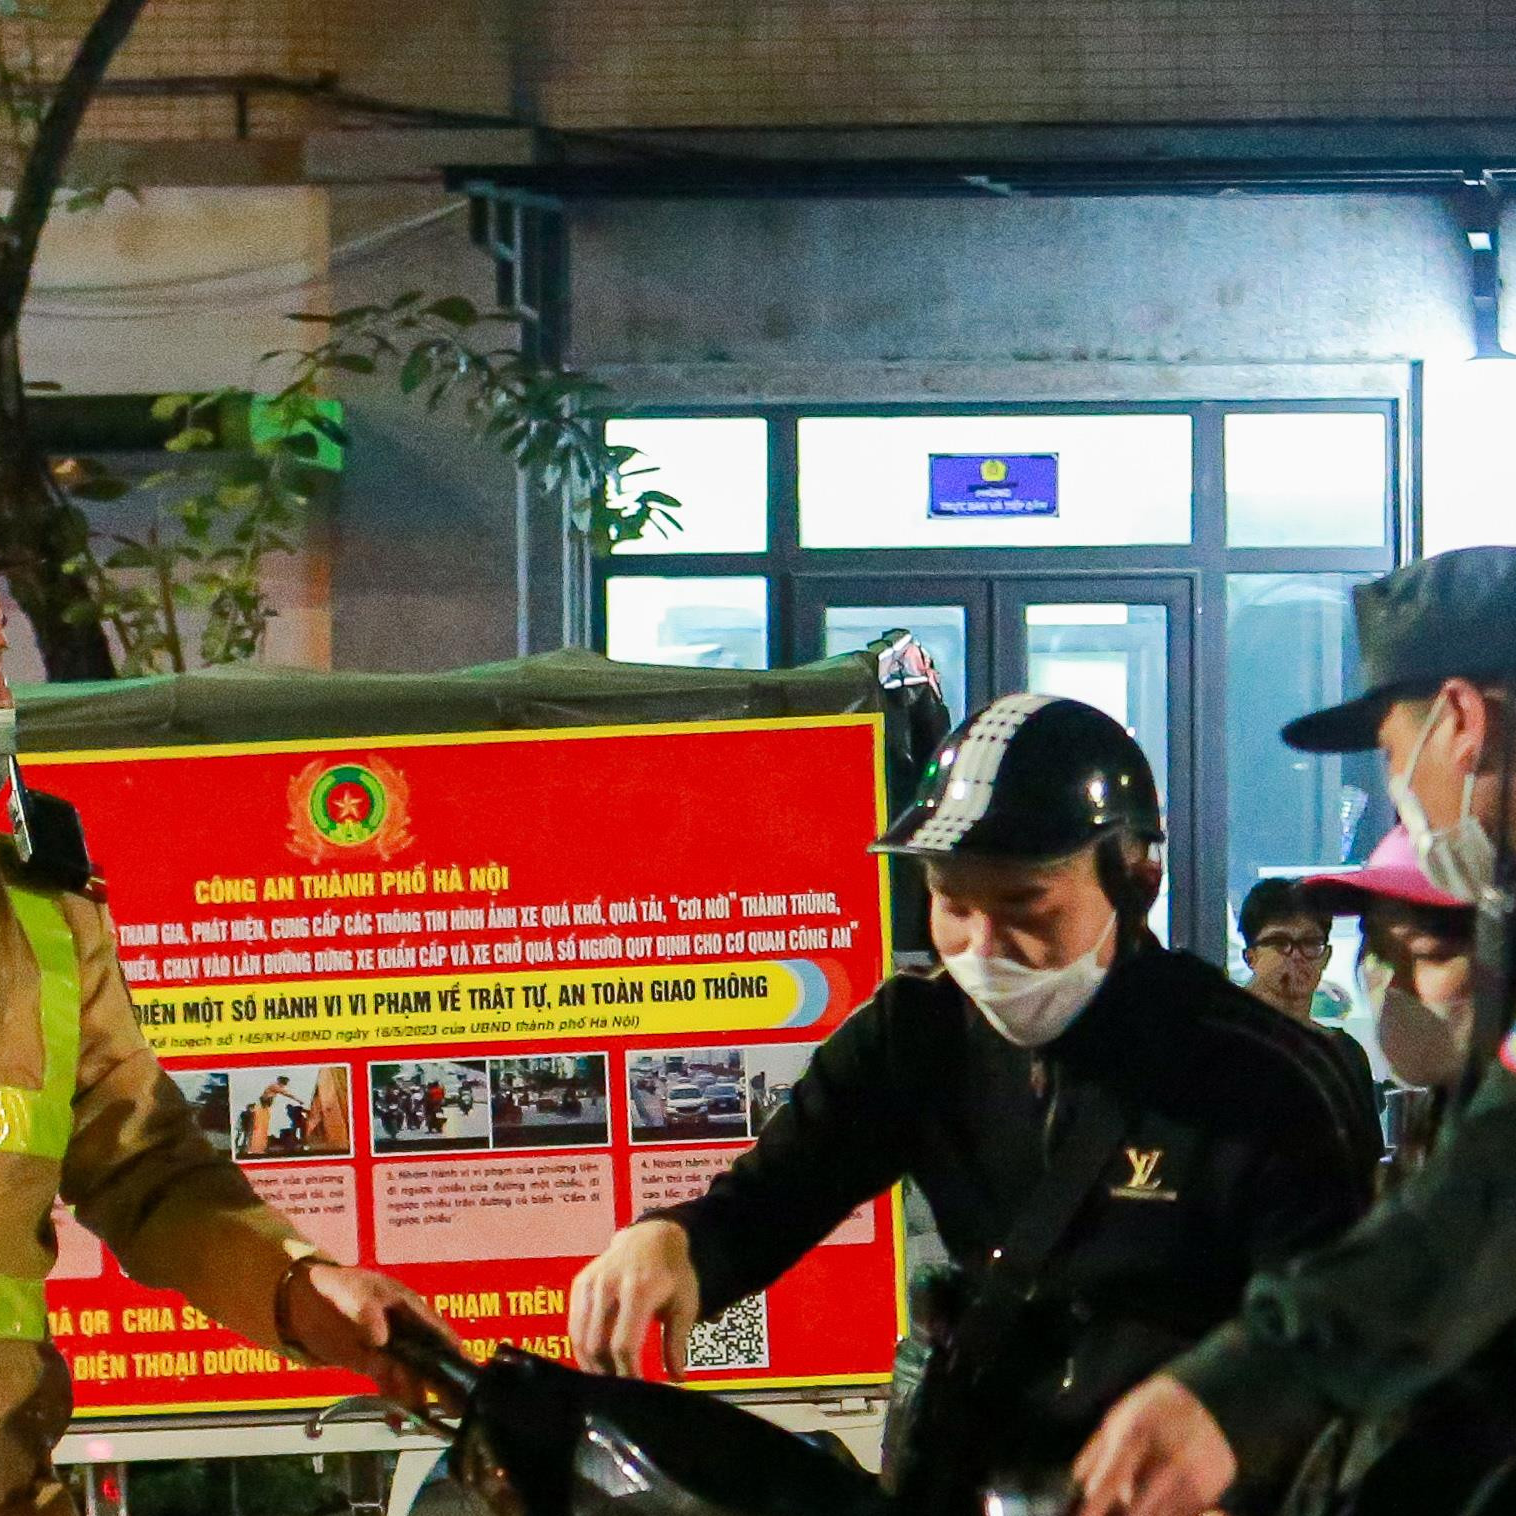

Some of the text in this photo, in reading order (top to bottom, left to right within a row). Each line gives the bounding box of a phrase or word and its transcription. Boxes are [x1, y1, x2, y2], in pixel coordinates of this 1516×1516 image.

[195, 861, 509, 904] CÔNG AN THÀNH PHỐ HÀ NỘI
[119, 925, 159, 946] THAM
[192, 918, 228, 943] PHÁT
[312, 908, 341, 936] CẤP
[344, 910, 372, 936] CÁC
[376, 908, 421, 934] THÔNG
[424, 910, 447, 932] TIN
[451, 905, 484, 930] HÌNH
[488, 900, 517, 928] ẢNH
[520, 906, 538, 927] XE
[542, 900, 570, 928] QUÁ
[609, 896, 637, 925] QUÁ
[740, 892, 786, 917] THÀNH
[790, 889, 841, 915] THÙNG,
[163, 957, 200, 984] CHẠY
[202, 952, 230, 977] VÀO
[233, 951, 262, 976] LÀN
[264, 948, 312, 975] ĐƯỜNG
[314, 948, 353, 973] DỪNG
[356, 949, 374, 970] XE
[378, 939, 416, 969] KHẨN
[419, 940, 448, 968] CẤP
[450, 940, 469, 966] VÀ
[472, 944, 490, 965] XE
[494, 935, 522, 964] CHỞ
[525, 937, 553, 965] QUÁ
[557, 933, 576, 961] SỐ
[580, 933, 622, 960] NGƯỜI
[626, 937, 652, 960] QUY
[656, 935, 690, 960] ĐỊNH
[694, 933, 722, 955] CHO
[725, 930, 745, 953] CƠ
[748, 930, 785, 954] QUAN
[789, 925, 827, 951] CÔNG
[183, 997, 223, 1029] MỘT
[231, 992, 257, 1021] SỐ
[264, 992, 317, 1020] HÀNH
[324, 995, 342, 1017] VI
[348, 994, 367, 1016] VI
[373, 991, 431, 1019] PHẠM
[438, 982, 461, 1012] VỀ
[467, 982, 515, 1015] TRẬT
[521, 983, 551, 1013] TỰ,
[558, 984, 585, 1007] AN
[591, 977, 643, 1005] TOÀN
[651, 979, 696, 1002] GIAO
[703, 972, 768, 1000] THÔNG
[216, 1032, 234, 1046] số
[336, 1027, 369, 1042] ngày
[441, 1022, 465, 1035] của
[470, 1021, 511, 1034] UBND
[516, 1018, 555, 1032] thành
[559, 1016, 586, 1032] phố
[80, 1310, 111, 1337] QR
[122, 1307, 177, 1334] CHIA
[434, 1291, 500, 1323] PHẠM
[506, 1285, 565, 1316] TRÊN
[74, 1351, 127, 1385] ĐIỆN
[131, 1351, 197, 1382] THOẠI
